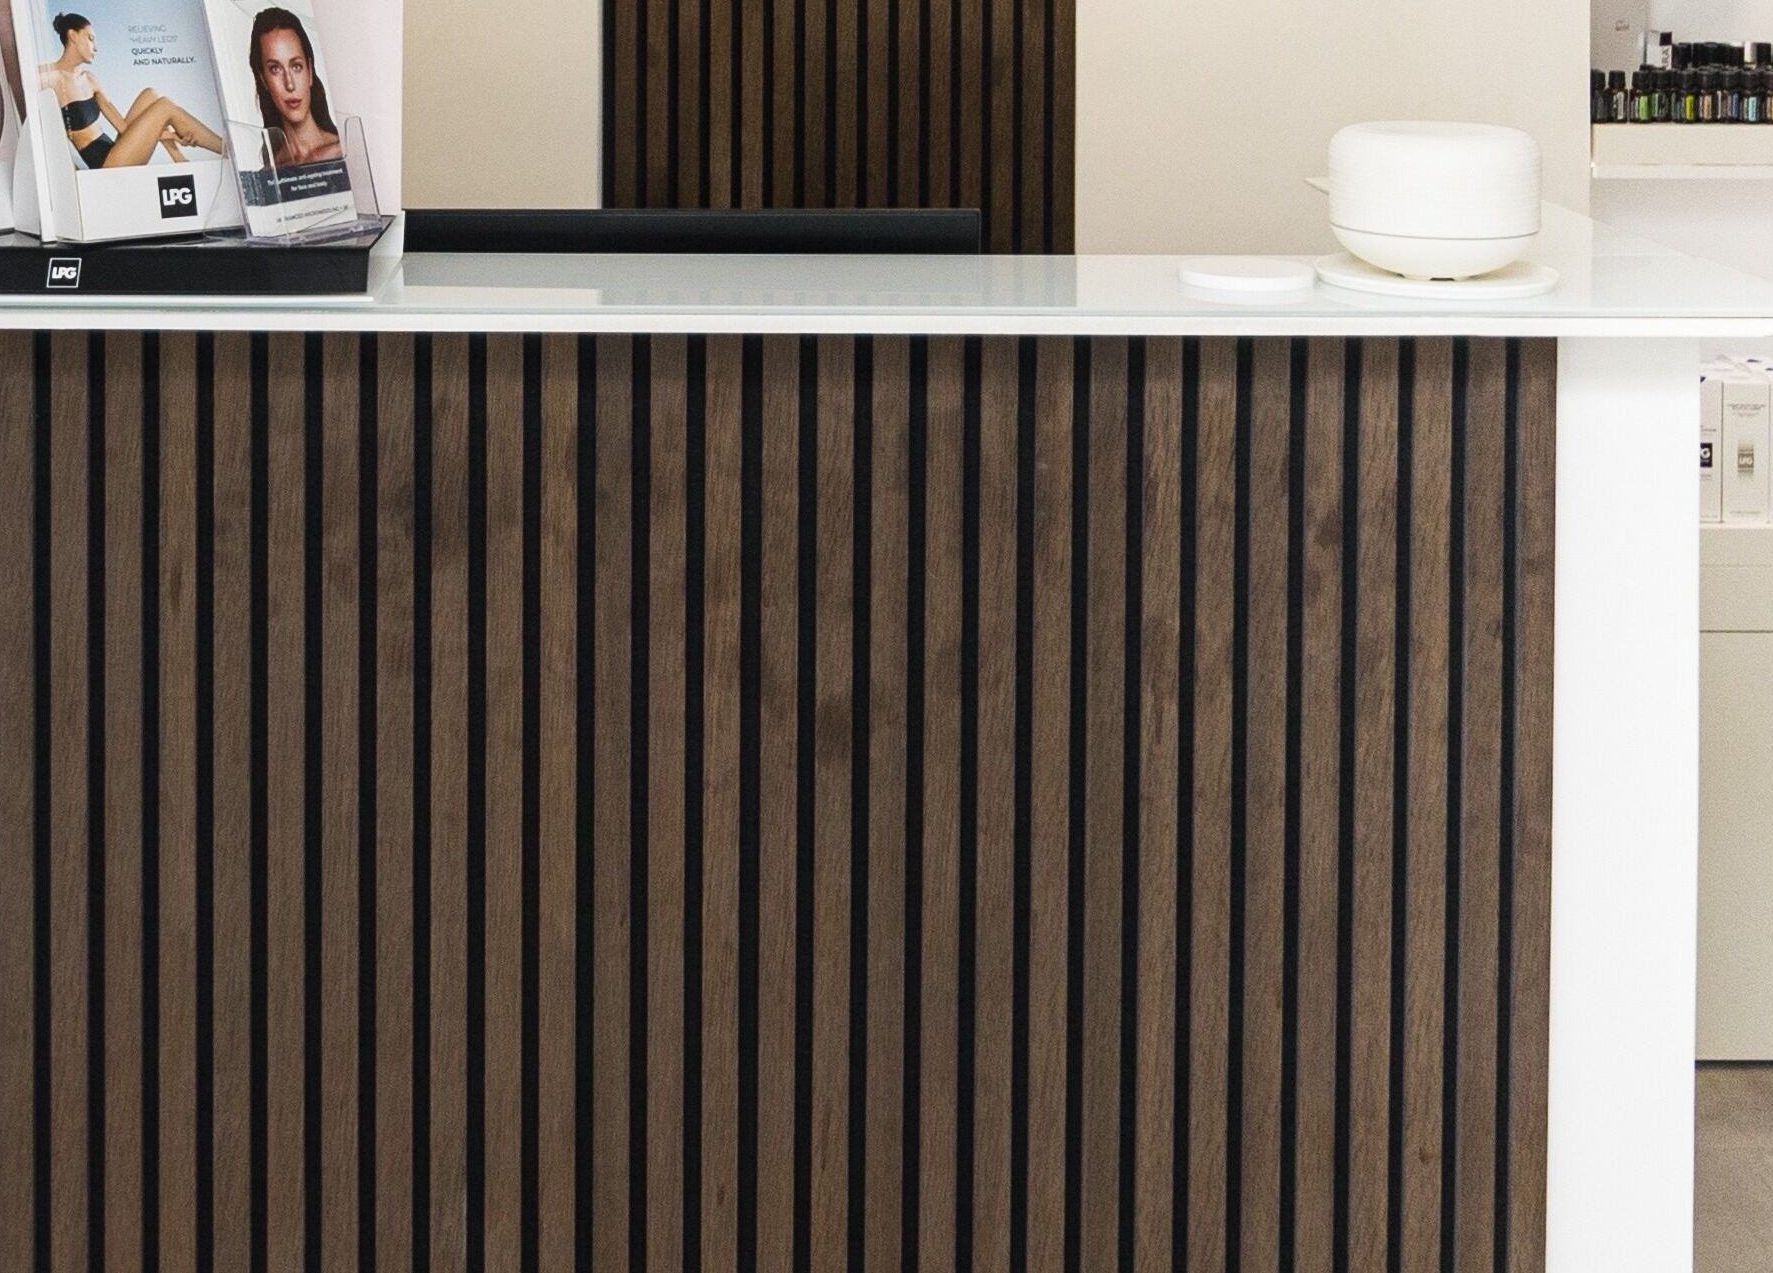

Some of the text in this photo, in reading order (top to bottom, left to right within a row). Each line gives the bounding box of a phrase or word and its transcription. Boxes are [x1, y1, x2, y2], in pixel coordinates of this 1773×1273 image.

[131, 47, 164, 56] QUICKLY
[133, 56, 197, 66] AND NATURALLY.
[161, 187, 193, 207] LPG
[51, 266, 78, 280] LPG
